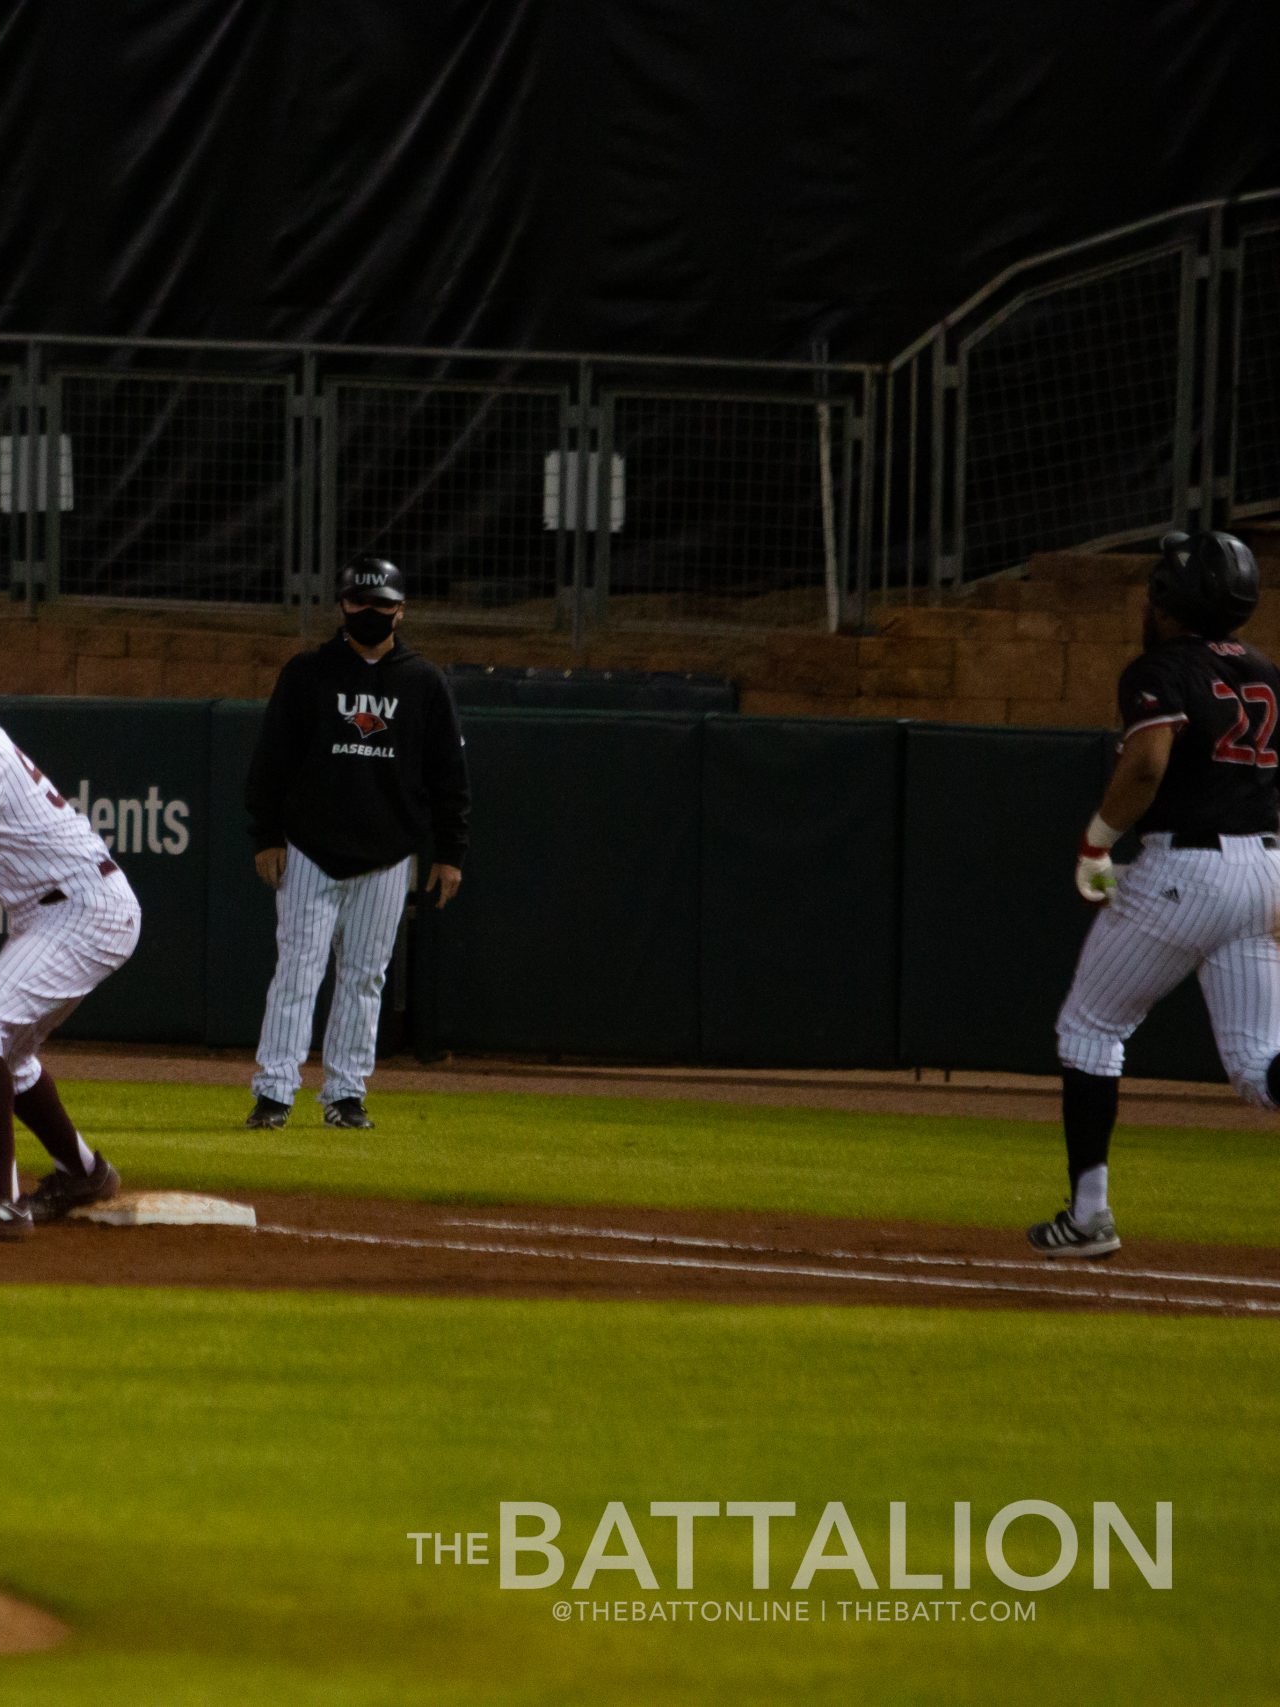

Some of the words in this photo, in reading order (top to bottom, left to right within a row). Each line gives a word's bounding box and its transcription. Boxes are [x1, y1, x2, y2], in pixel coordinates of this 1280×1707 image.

[355, 572, 389, 586] UIW
[337, 693, 399, 720] UIW
[1210, 679, 1279, 768] 22
[331, 743, 396, 759] BASEBALL
